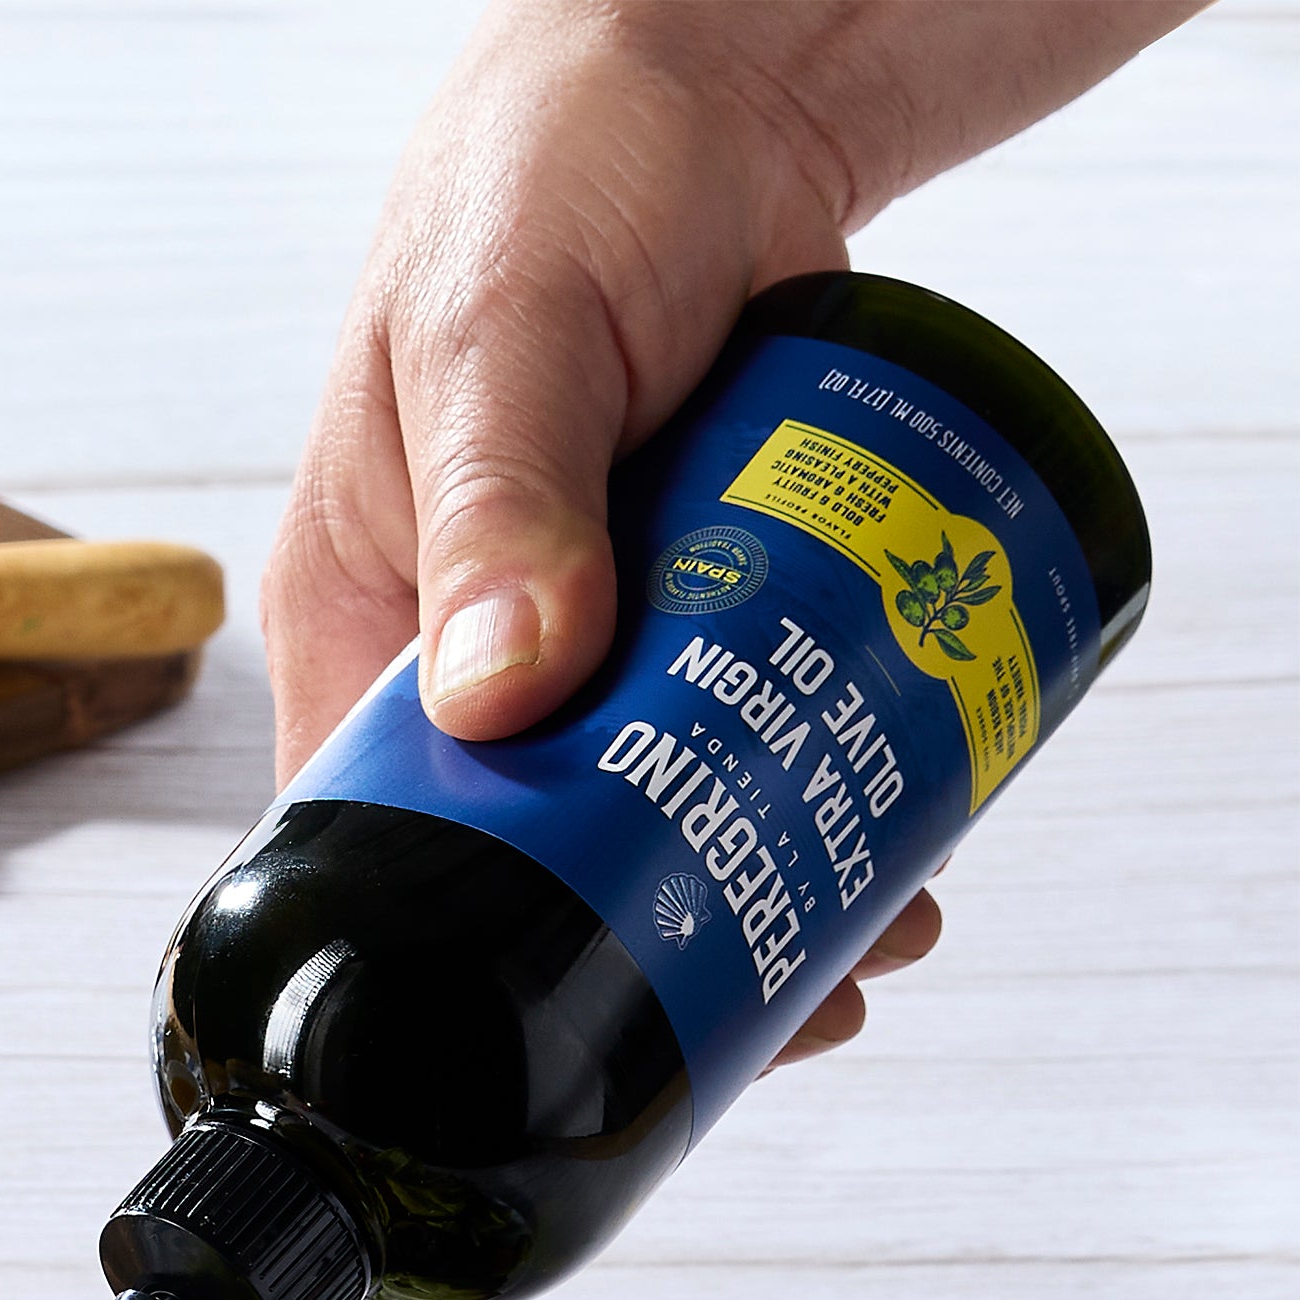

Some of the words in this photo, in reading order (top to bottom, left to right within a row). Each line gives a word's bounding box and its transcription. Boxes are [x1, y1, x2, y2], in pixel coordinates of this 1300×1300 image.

[818, 368, 850, 392] OZ)
[847, 378, 869, 399] FL
[862, 387, 894, 411] (17
[889, 398, 914, 421] ML
[908, 410, 944, 440] 500
[785, 448, 846, 479] PLEASING
[800, 438, 843, 461] FINISH
[937, 429, 1003, 493] CONTENTS
[771, 460, 833, 489] AROMATIC
[773, 477, 819, 500] FRUITY
[843, 457, 899, 494] PEPPERY
[847, 474, 858, 485] A
[765, 494, 808, 514] PROFILE
[819, 495, 830, 505] &
[834, 485, 845, 496] &
[858, 482, 892, 509] WITH
[996, 486, 1025, 519] NET
[831, 502, 865, 526] BOLD
[845, 492, 886, 523] FRESH
[812, 513, 852, 540] FLAVOR
[672, 558, 741, 584] SPAIN
[1049, 567, 1071, 612] SPOUT
[768, 616, 835, 695] OIL
[992, 656, 1006, 682] THE
[666, 636, 812, 771] VIRGIN
[821, 681, 904, 818] OLIVE
[690, 721, 771, 819] TIENDA
[802, 753, 876, 910] EXTRA
[597, 720, 807, 1004] PEREGRINO
[777, 831, 799, 867] LA
[798, 880, 817, 913] BY
